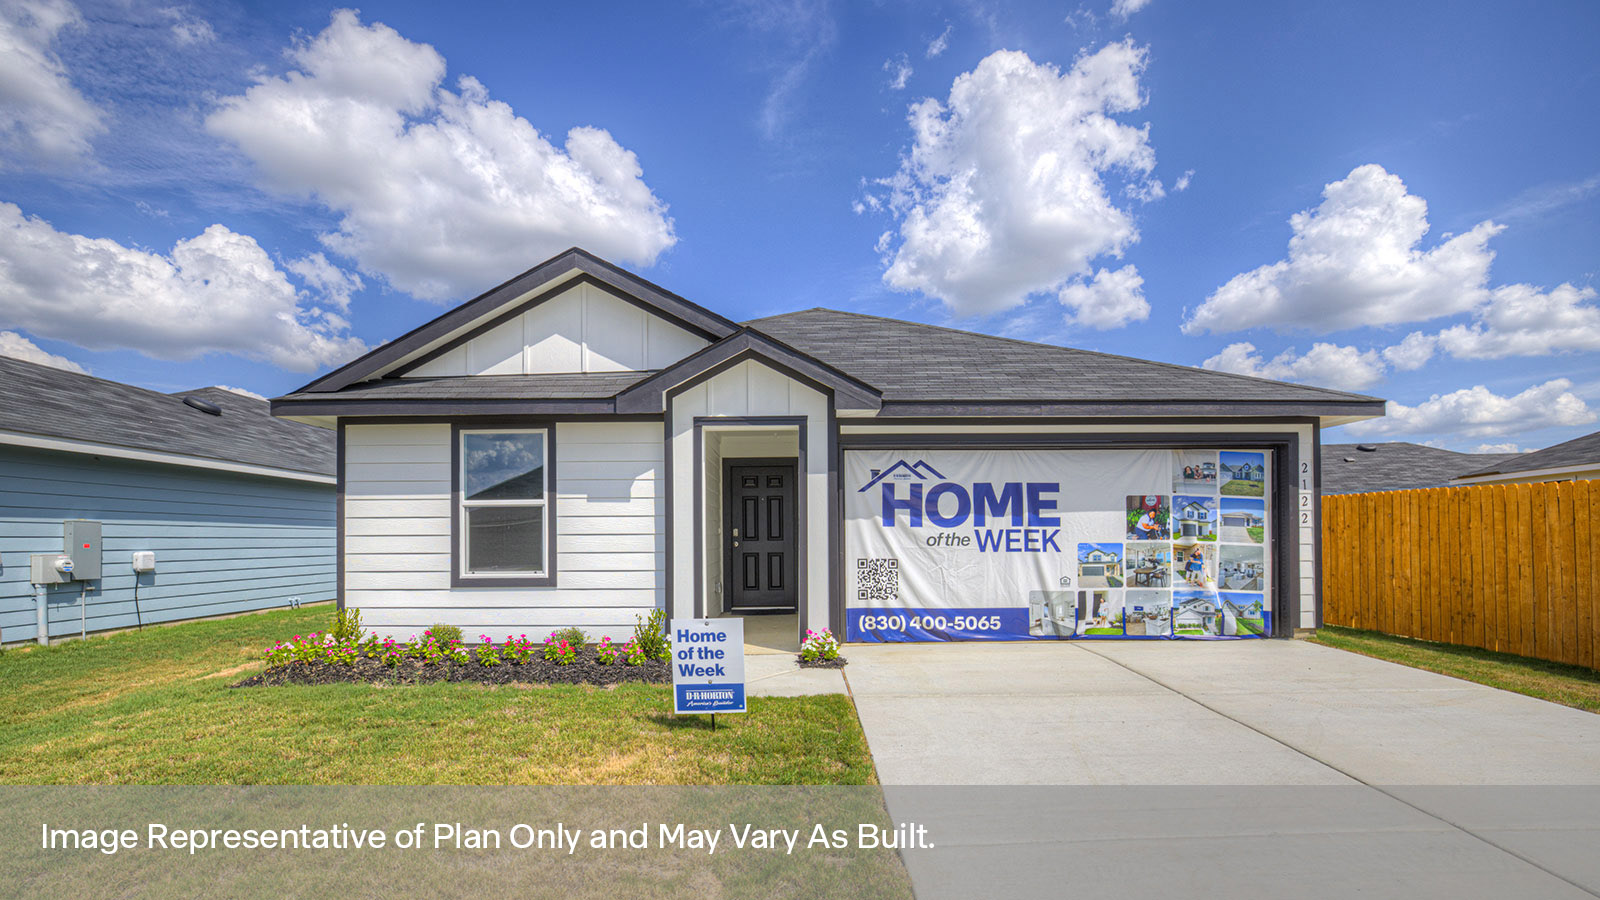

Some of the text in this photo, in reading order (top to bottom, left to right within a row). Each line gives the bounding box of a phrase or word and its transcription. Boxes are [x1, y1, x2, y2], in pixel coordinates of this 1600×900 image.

[882, 482, 1061, 528] HOME
[926, 529, 1061, 553] of the WEEK
[858, 615, 1001, 633] (830) 400-5065
[677, 629, 727, 643] Home
[678, 646, 725, 660] of the
[678, 663, 725, 677] Week
